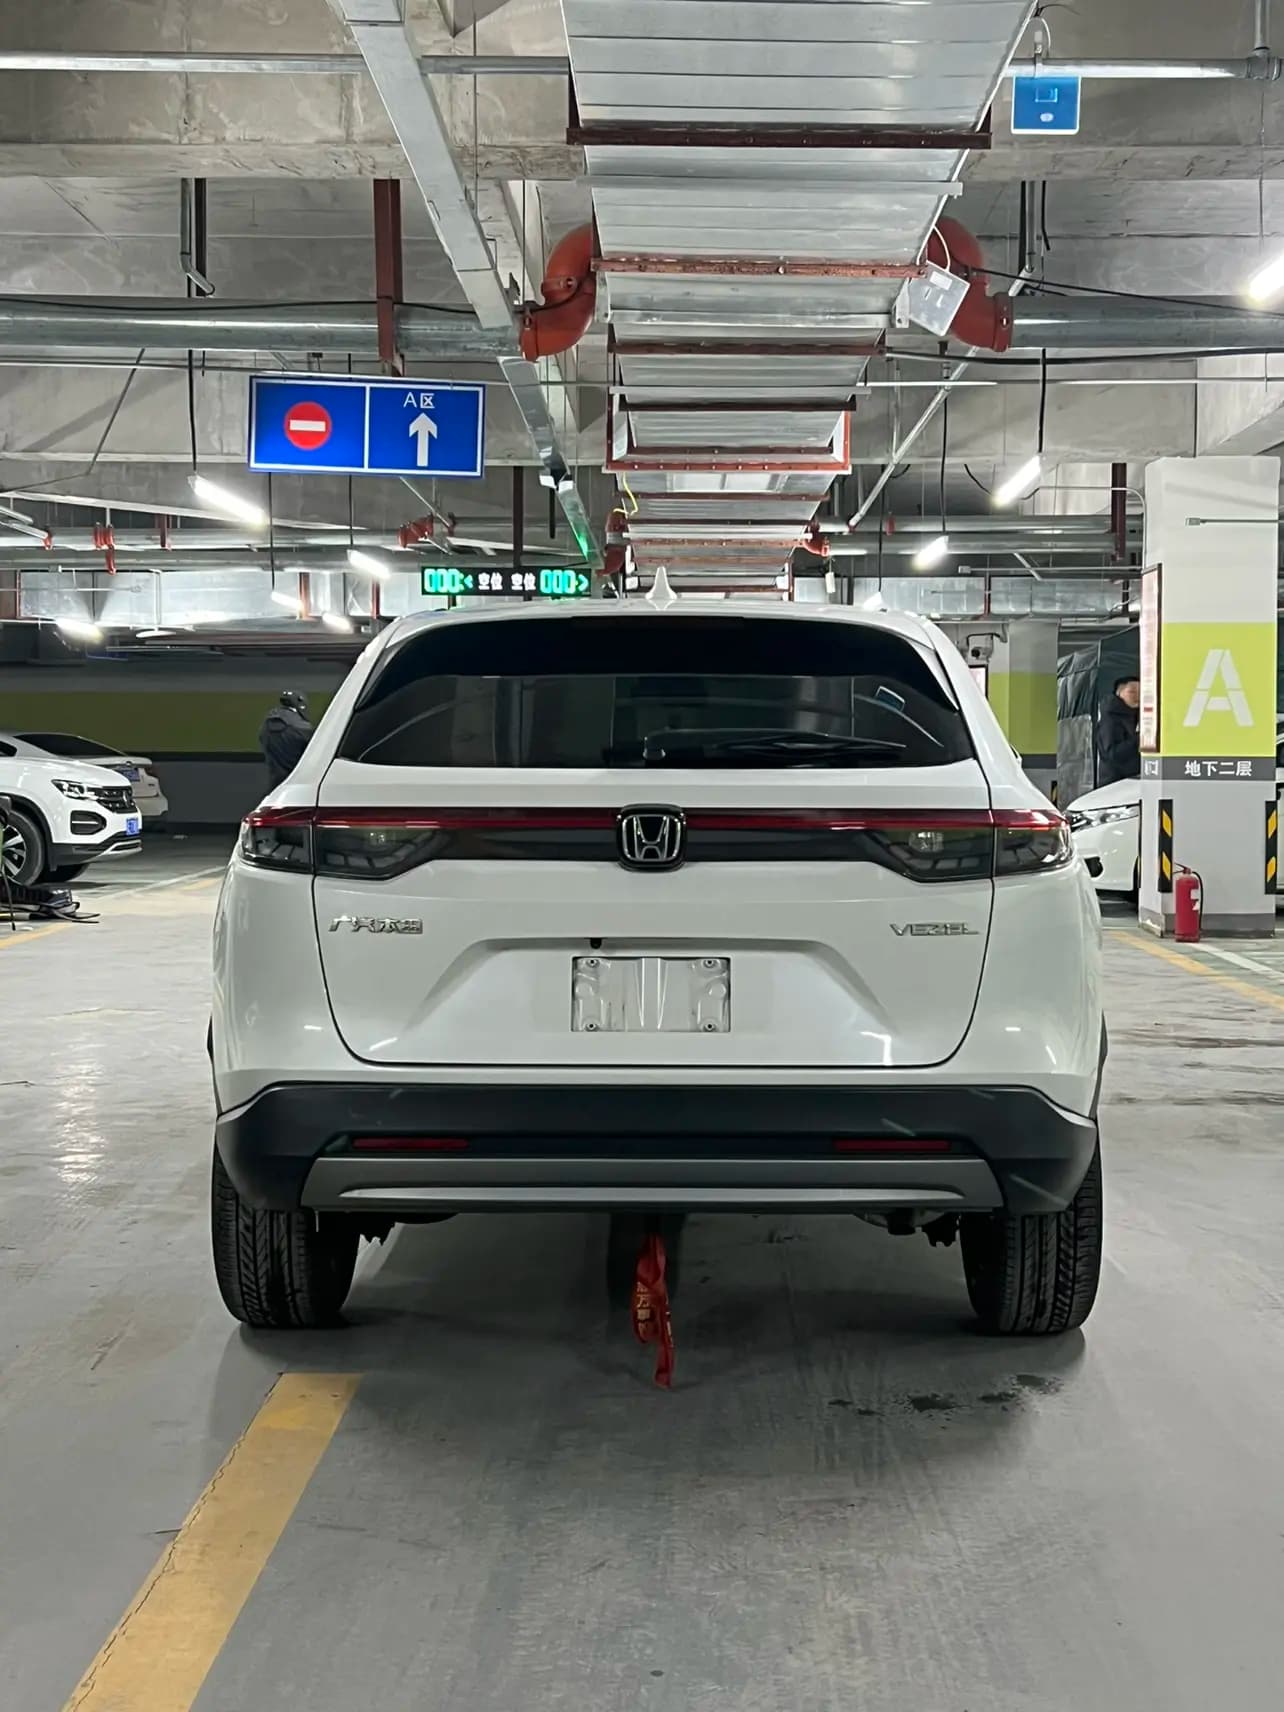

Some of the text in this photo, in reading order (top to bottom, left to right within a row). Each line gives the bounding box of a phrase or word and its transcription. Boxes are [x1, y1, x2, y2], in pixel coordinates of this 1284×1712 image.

[403, 391, 435, 409] A区
[1183, 648, 1255, 728] A
[1184, 760, 1252, 777] 地下二层
[889, 923, 980, 936] VEZEL
